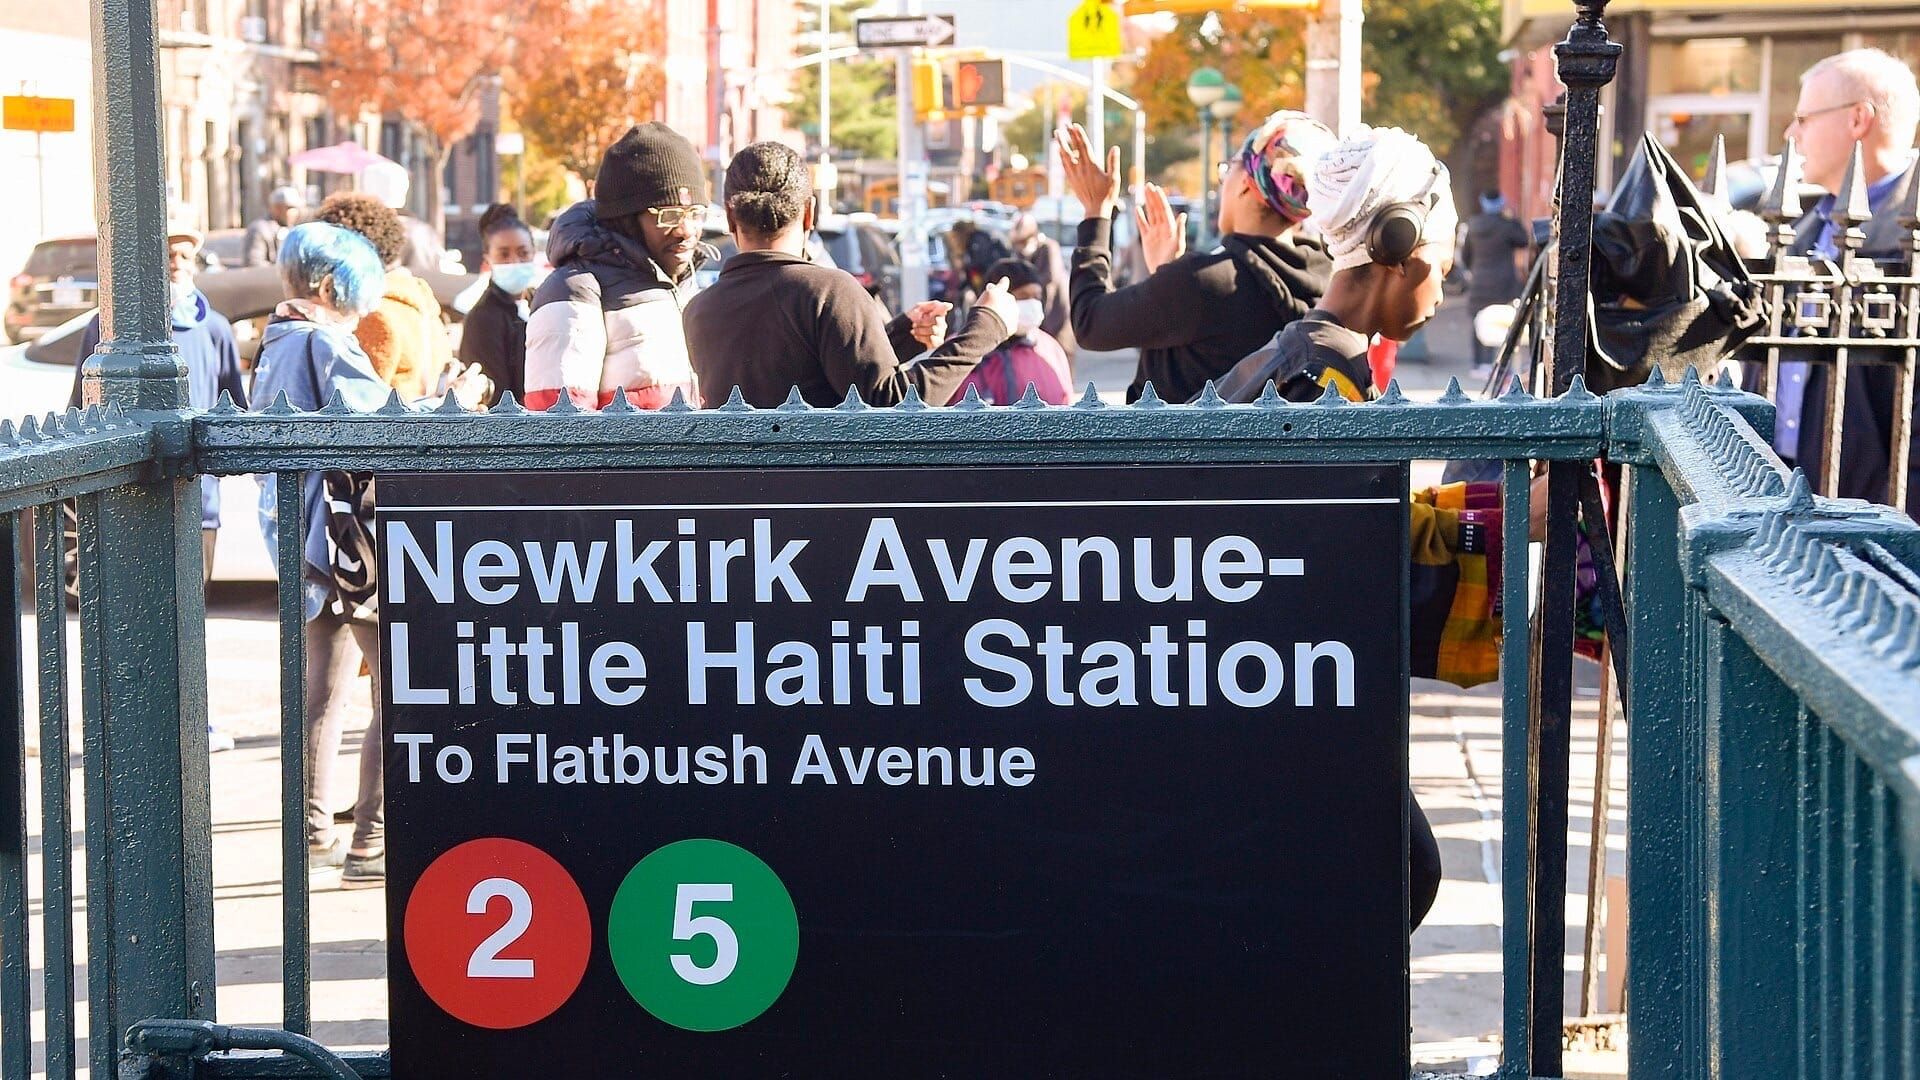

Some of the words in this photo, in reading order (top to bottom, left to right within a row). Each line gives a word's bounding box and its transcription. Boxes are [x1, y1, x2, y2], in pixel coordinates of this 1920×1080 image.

[387, 518, 812, 605] Newkirk
[845, 517, 1305, 604] Avenue-
[391, 620, 646, 706] Little
[687, 620, 920, 707] Haiti
[964, 618, 1355, 708] Station
[394, 733, 473, 784] To
[497, 733, 768, 785] Flatbush
[791, 734, 1036, 787] Avenue
[466, 877, 535, 979] 2
[669, 883, 739, 986] 5
